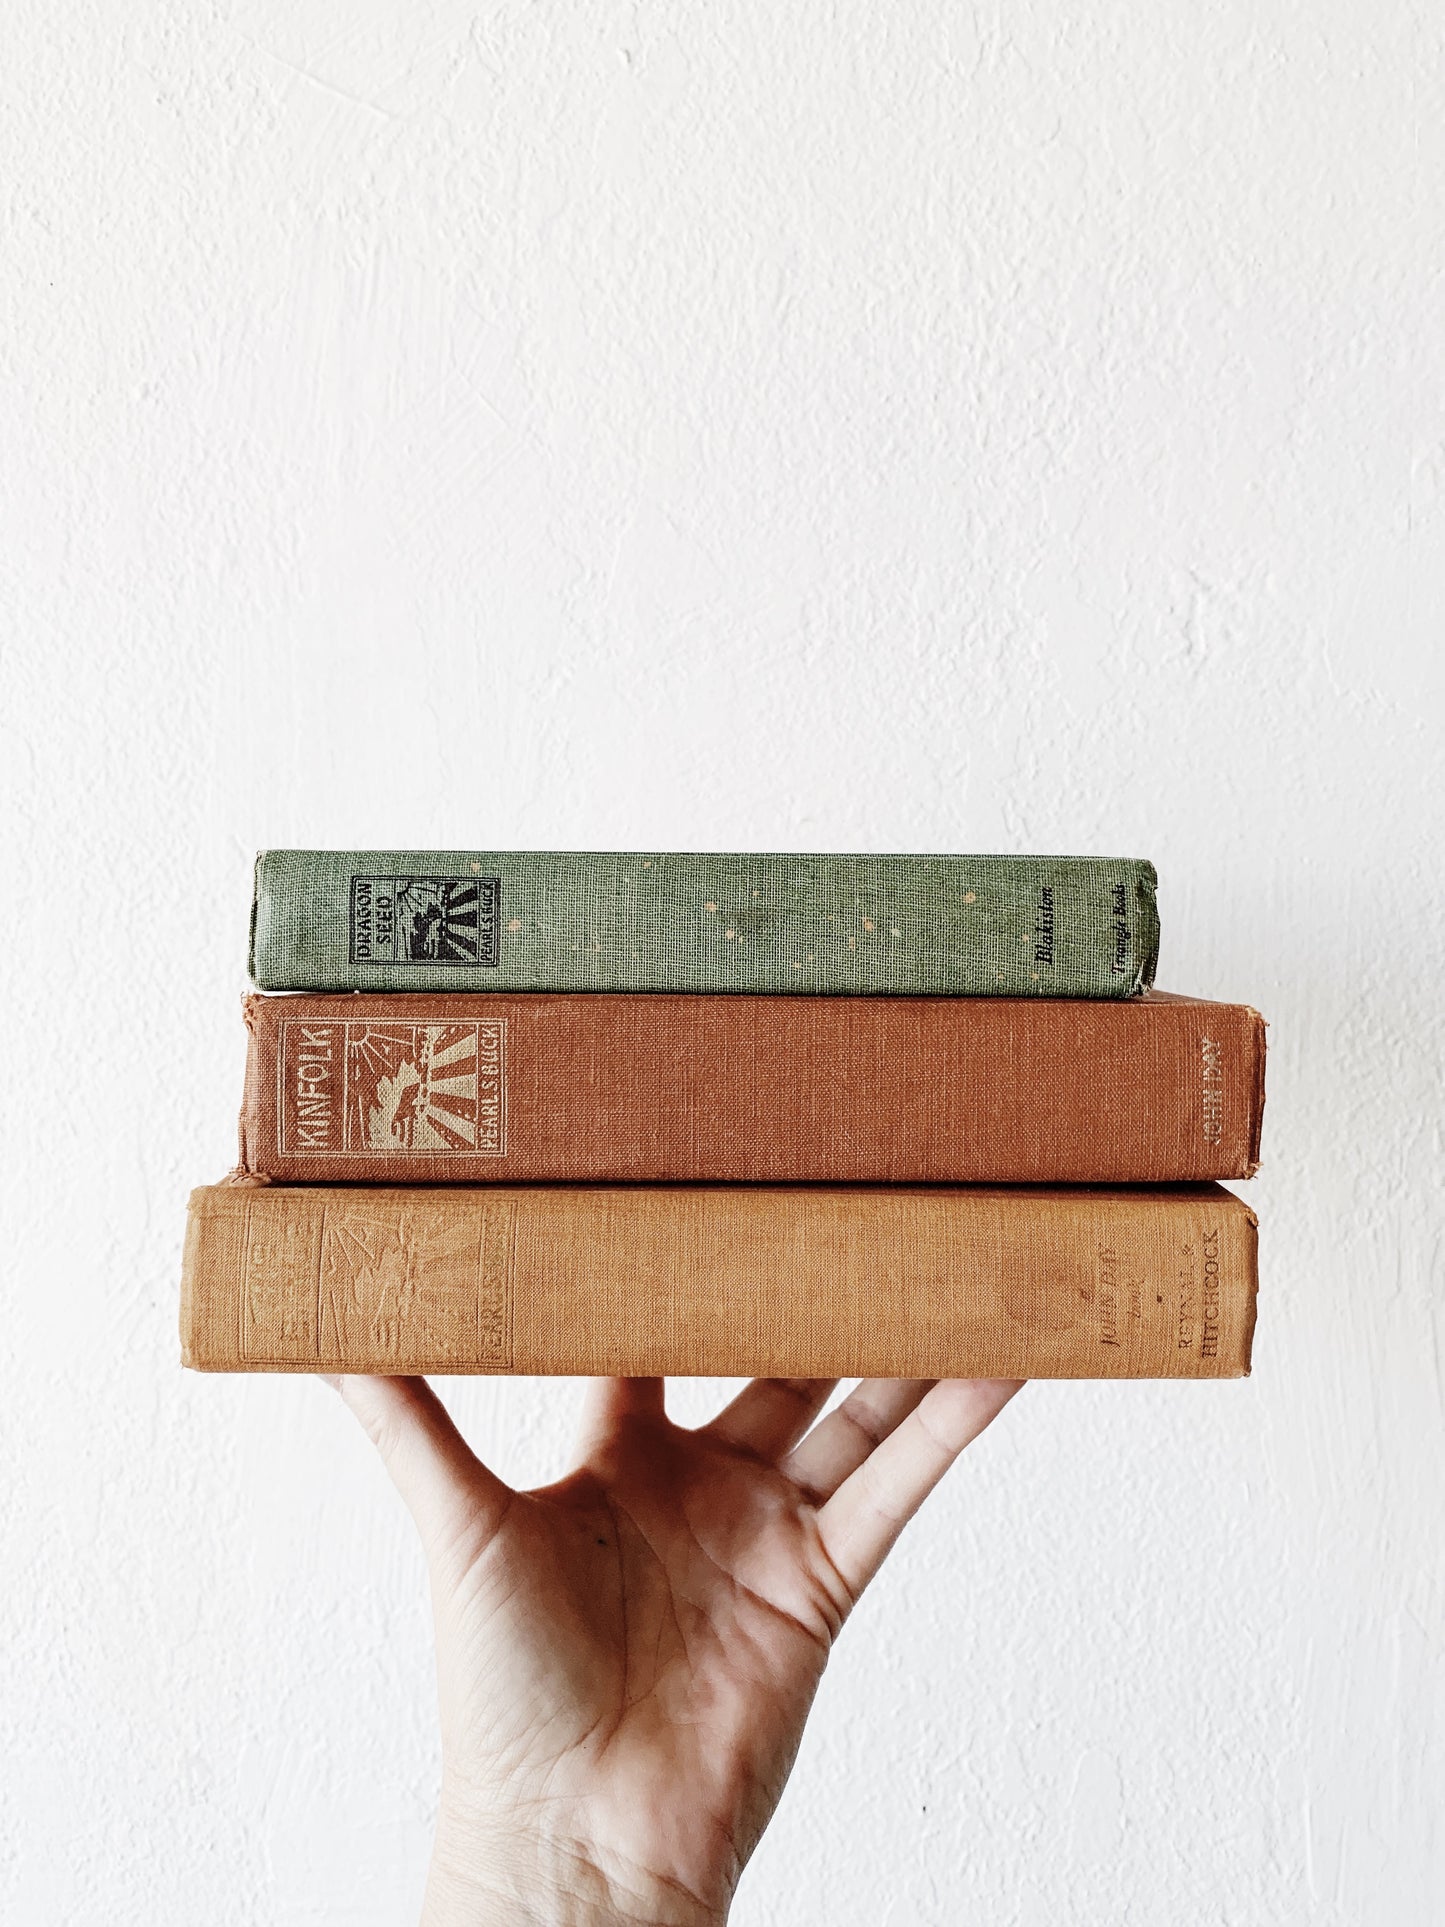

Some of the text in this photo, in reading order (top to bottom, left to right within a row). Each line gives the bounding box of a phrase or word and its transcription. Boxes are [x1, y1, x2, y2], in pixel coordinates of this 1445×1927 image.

[356, 883, 372, 958] DRAGON
[375, 895, 392, 945] SEED
[480, 883, 494, 914] BUCK
[1034, 886, 1053, 965] Blakiston
[480, 924, 493, 961] PEARL
[1110, 921, 1131, 974] Triangle
[479, 1025, 499, 1076] BUCK
[297, 1028, 332, 1147] KINFOLK
[1201, 1035, 1222, 1145] JOHN DAY
[479, 1095, 499, 1150] PEARL
[1201, 1228, 1220, 1358] HITCHCOCK
